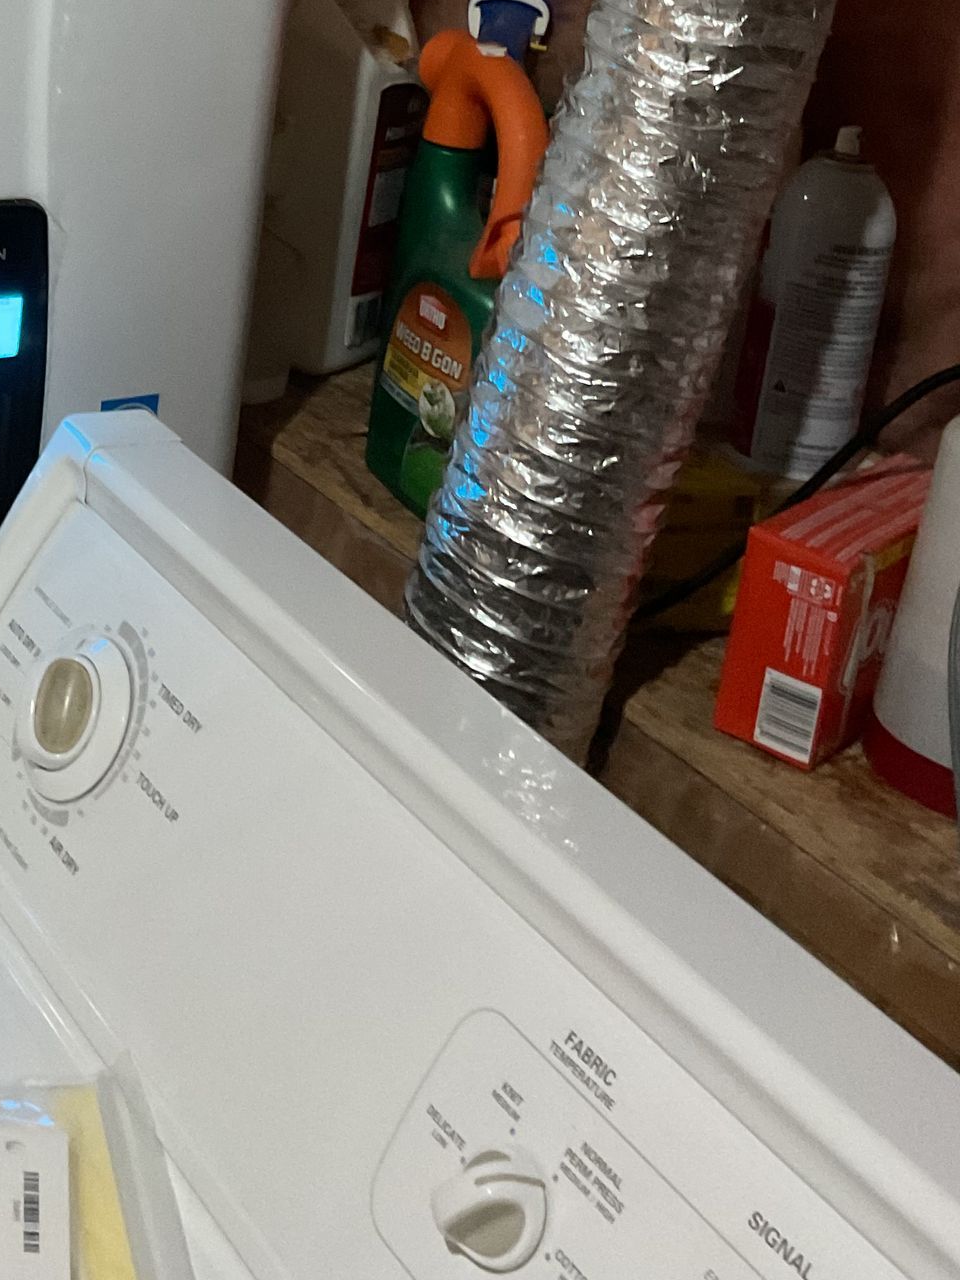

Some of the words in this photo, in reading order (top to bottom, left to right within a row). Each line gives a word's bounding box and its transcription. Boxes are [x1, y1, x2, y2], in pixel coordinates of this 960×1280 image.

[421, 340, 432, 362] B
[431, 348, 464, 380] GON
[159, 683, 185, 716] TIMED
[182, 710, 203, 734] DRY
[135, 770, 166, 812] TOUCH
[164, 803, 180, 822] UP
[61, 851, 80, 876] DRY
[549, 1039, 617, 1112] TEMPERATURE
[563, 1030, 617, 1087] FABRIC
[426, 1103, 467, 1152] DELICATE
[564, 1146, 594, 1181] PERM
[591, 1175, 625, 1215] PRESS
[580, 1141, 623, 1191] NORMAL
[747, 1210, 814, 1280] SIGNAL
